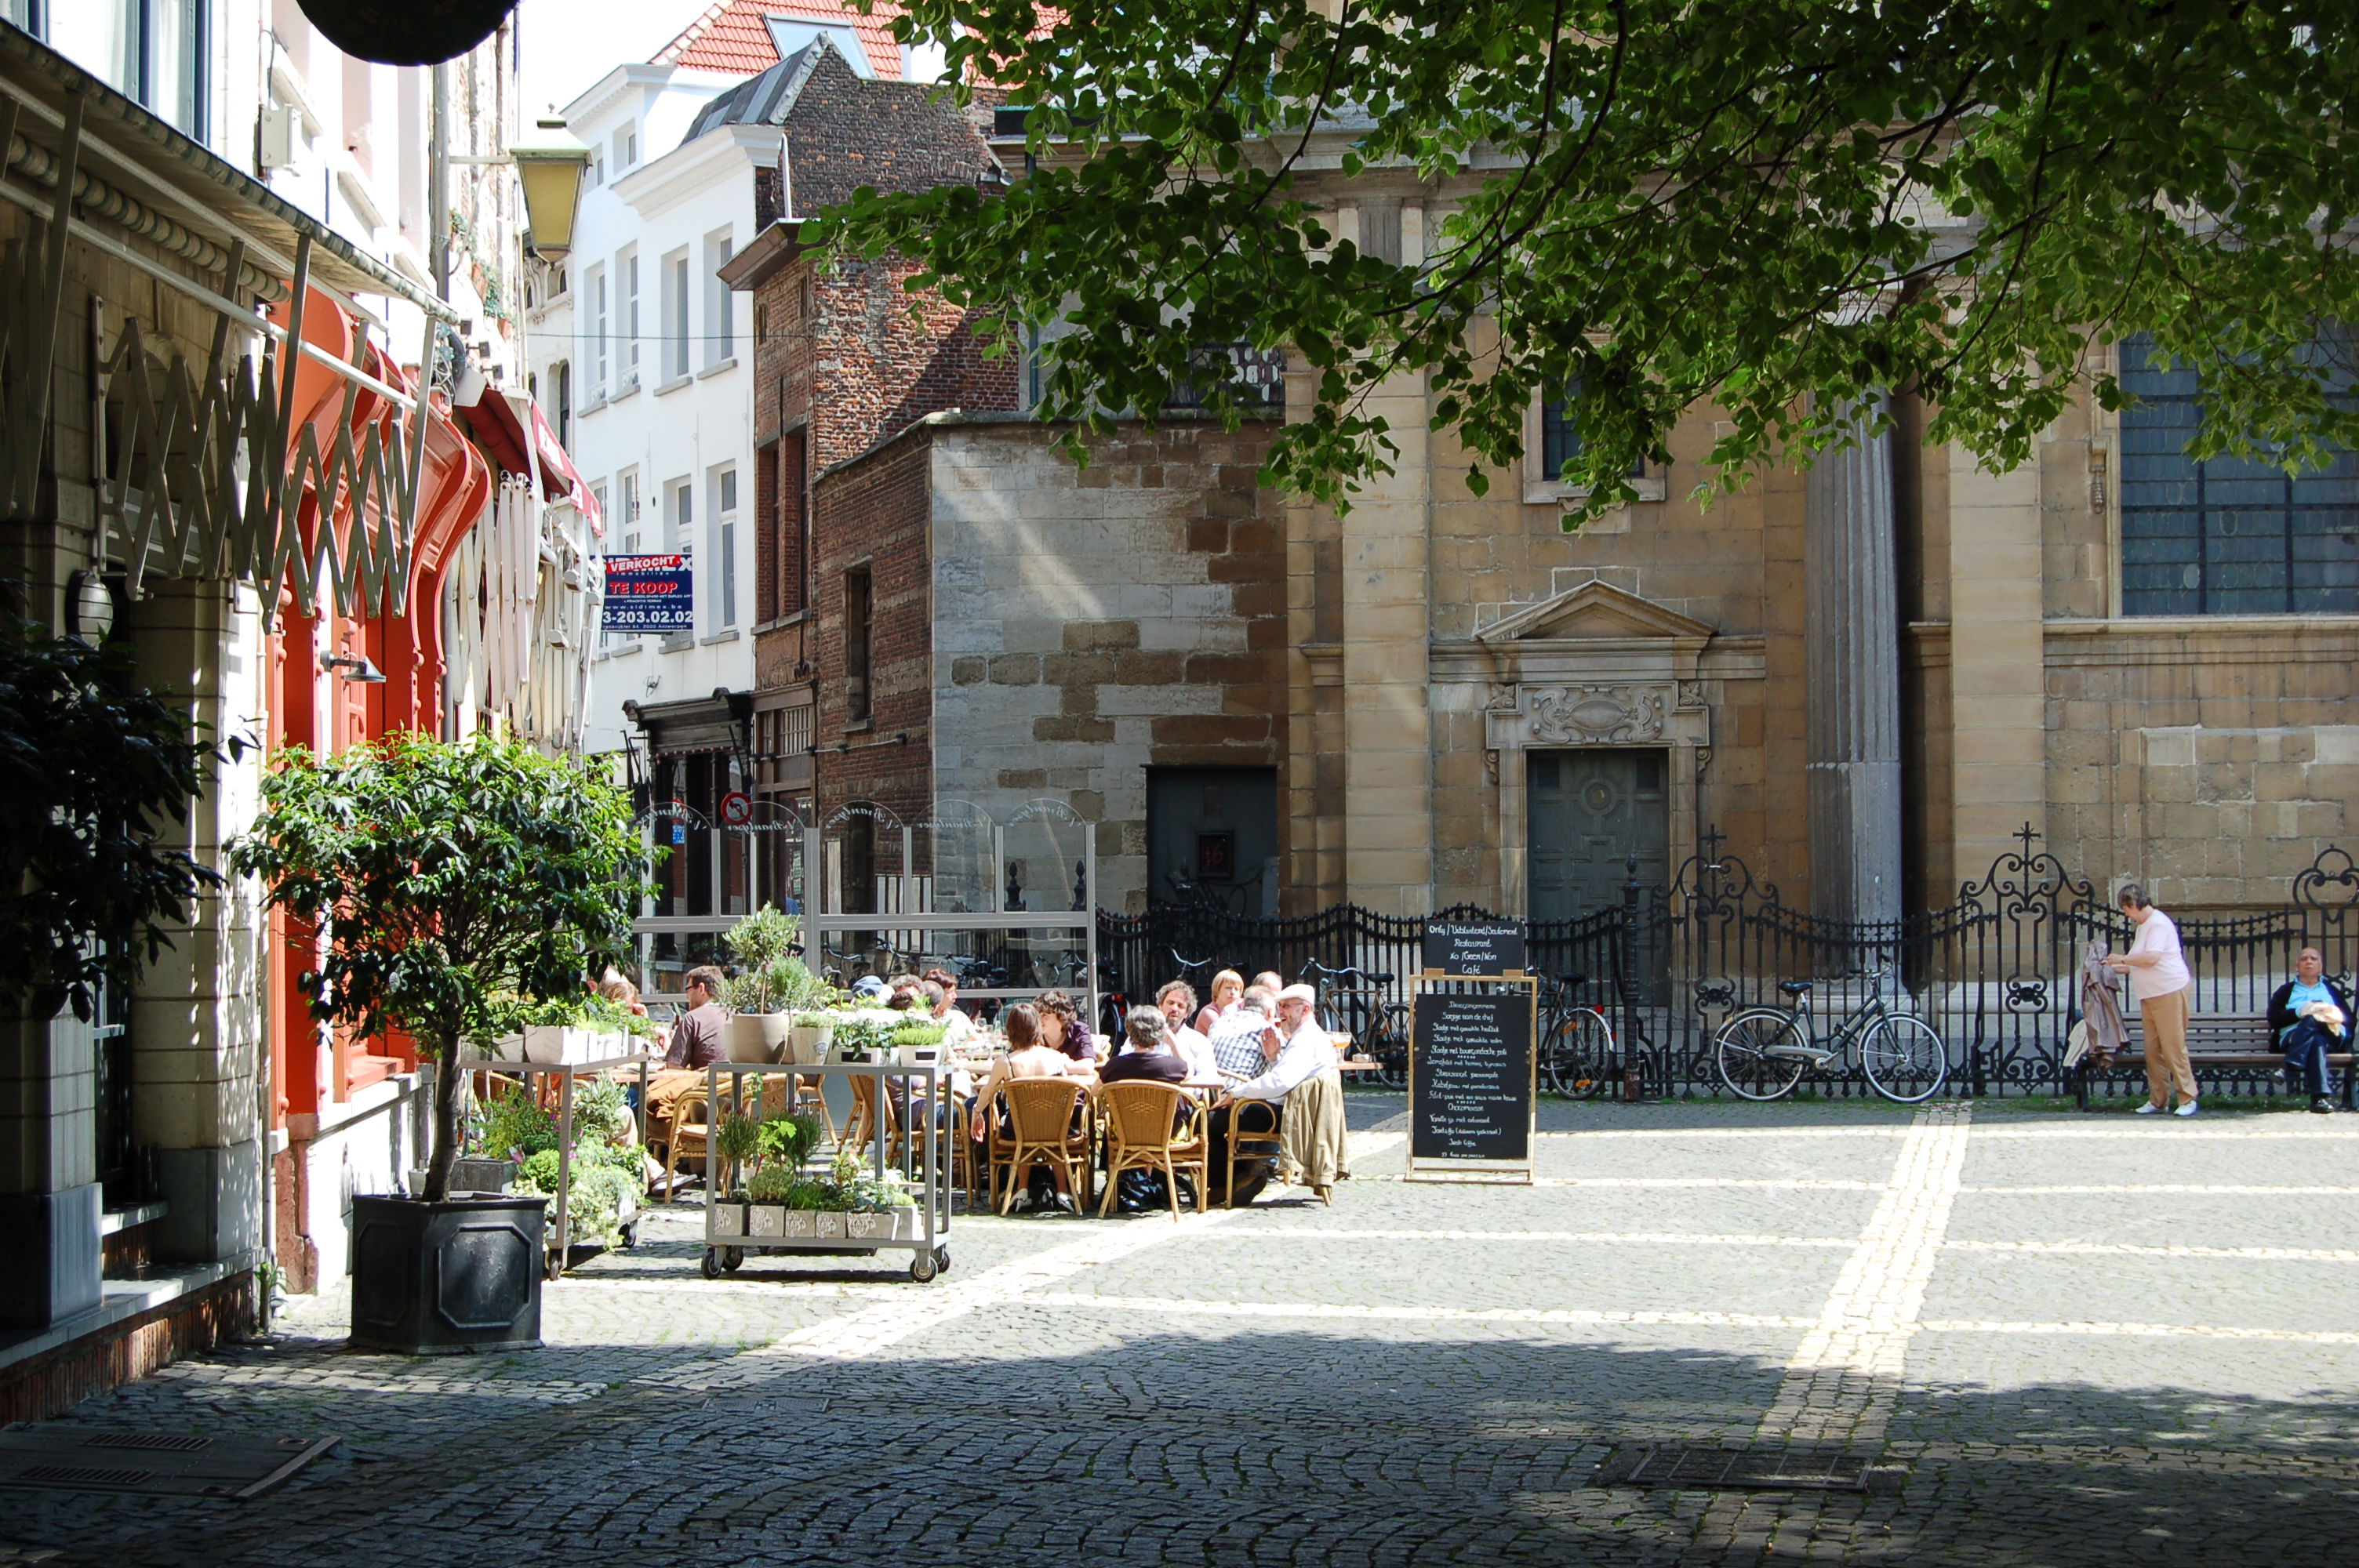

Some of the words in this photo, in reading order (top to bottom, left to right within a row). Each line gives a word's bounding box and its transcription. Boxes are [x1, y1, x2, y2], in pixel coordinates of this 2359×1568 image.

[609, 583, 630, 594] TE
[634, 582, 678, 594] KOOP
[1429, 925, 1445, 936] Only
[1454, 938, 1492, 948] Restaurant
[1462, 964, 1481, 975] Café
[1482, 1013, 1494, 1022] chef
